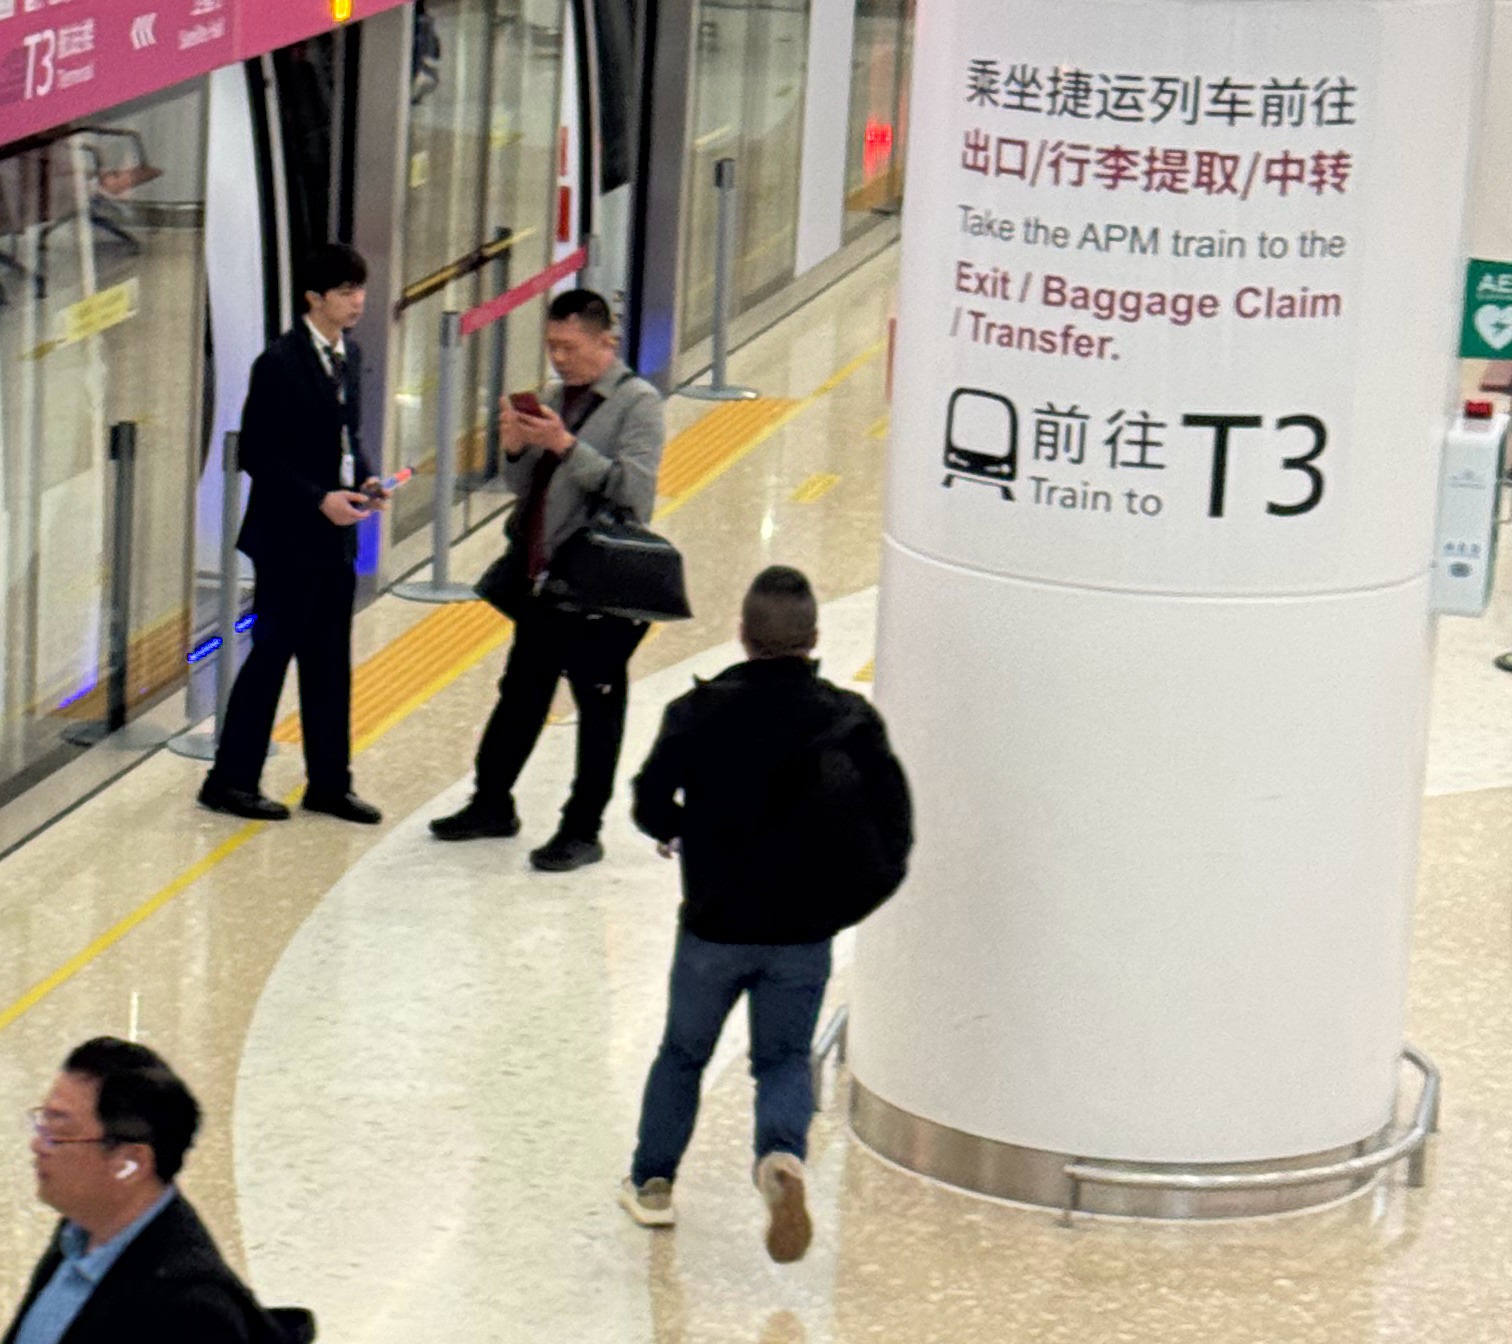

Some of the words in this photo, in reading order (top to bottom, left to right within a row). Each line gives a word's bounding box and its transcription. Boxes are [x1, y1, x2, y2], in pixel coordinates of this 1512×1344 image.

[23, 27, 56, 100] T3
[965, 58, 1358, 128] 乘坐捷运列车前往
[960, 127, 1354, 202] 出口/行李提取/中转
[958, 204, 1016, 242] Take
[1023, 216, 1069, 249] the
[1076, 222, 1160, 256] APM
[1172, 229, 1246, 259] train
[1257, 233, 1288, 259] to
[1299, 229, 1348, 259] the
[954, 259, 1012, 302] Exit
[1041, 273, 1221, 327] Baggage
[1233, 285, 1343, 320] Claim
[967, 310, 1121, 362] Transfer.
[1032, 401, 1168, 470] 前往
[1180, 413, 1328, 518] T3
[1028, 475, 1113, 514] Train
[1124, 488, 1164, 517] to
